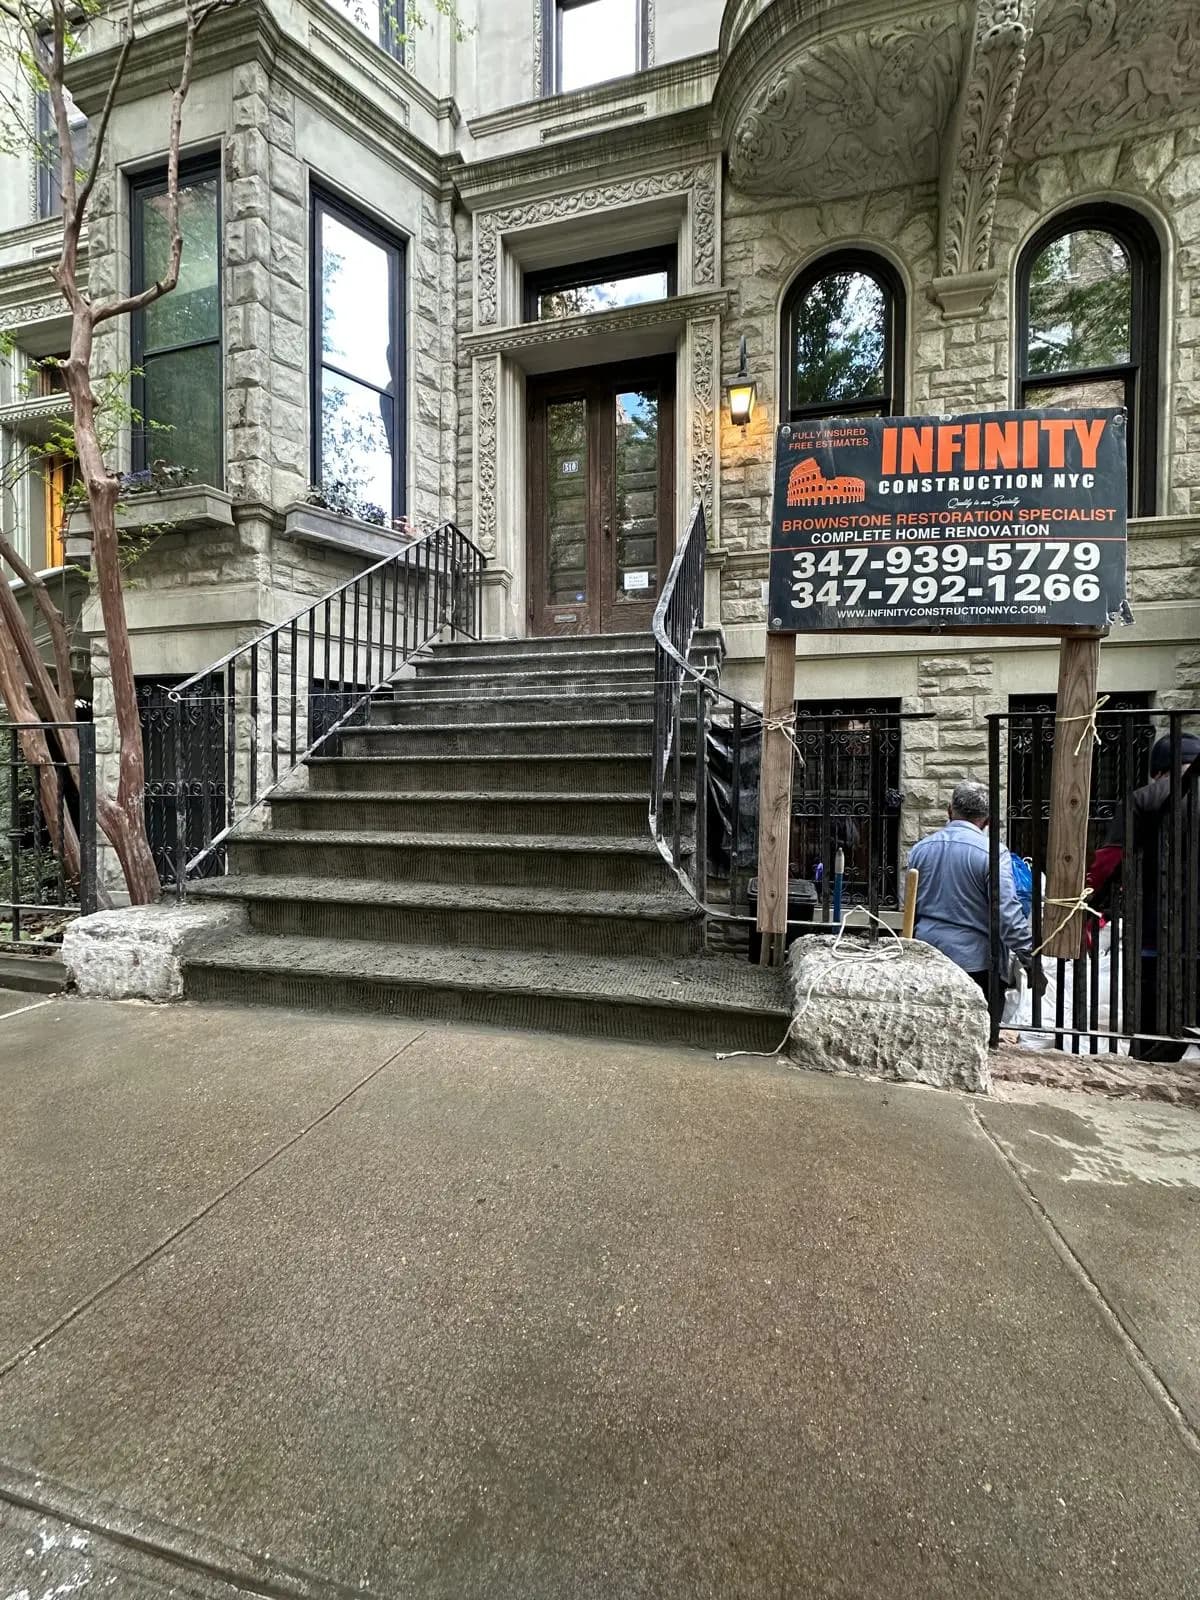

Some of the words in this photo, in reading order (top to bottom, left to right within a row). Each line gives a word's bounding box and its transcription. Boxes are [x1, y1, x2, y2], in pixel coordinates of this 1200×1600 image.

[788, 441, 813, 450] FREE
[815, 437, 869, 449] ESTIMATES
[792, 430, 821, 440] FULLY
[823, 428, 867, 438] INSURED
[881, 419, 1107, 475] INFINITY
[878, 474, 1043, 495] CONSTRUCTION
[1053, 473, 1095, 488] NYC
[782, 514, 892, 532] BROWNSTONE
[896, 510, 1014, 525] RESTORATION
[1018, 509, 1117, 521] SPECIALIST
[811, 529, 891, 545] COMPLETE
[895, 527, 941, 540] HOME
[945, 524, 1050, 538] RENOVATION
[792, 542, 1101, 579] 347-939-5779
[790, 573, 1100, 609] 347-792-1266
[837, 605, 1047, 618] WWW.INFINITYCONSTRUCTIONNYC.COM
